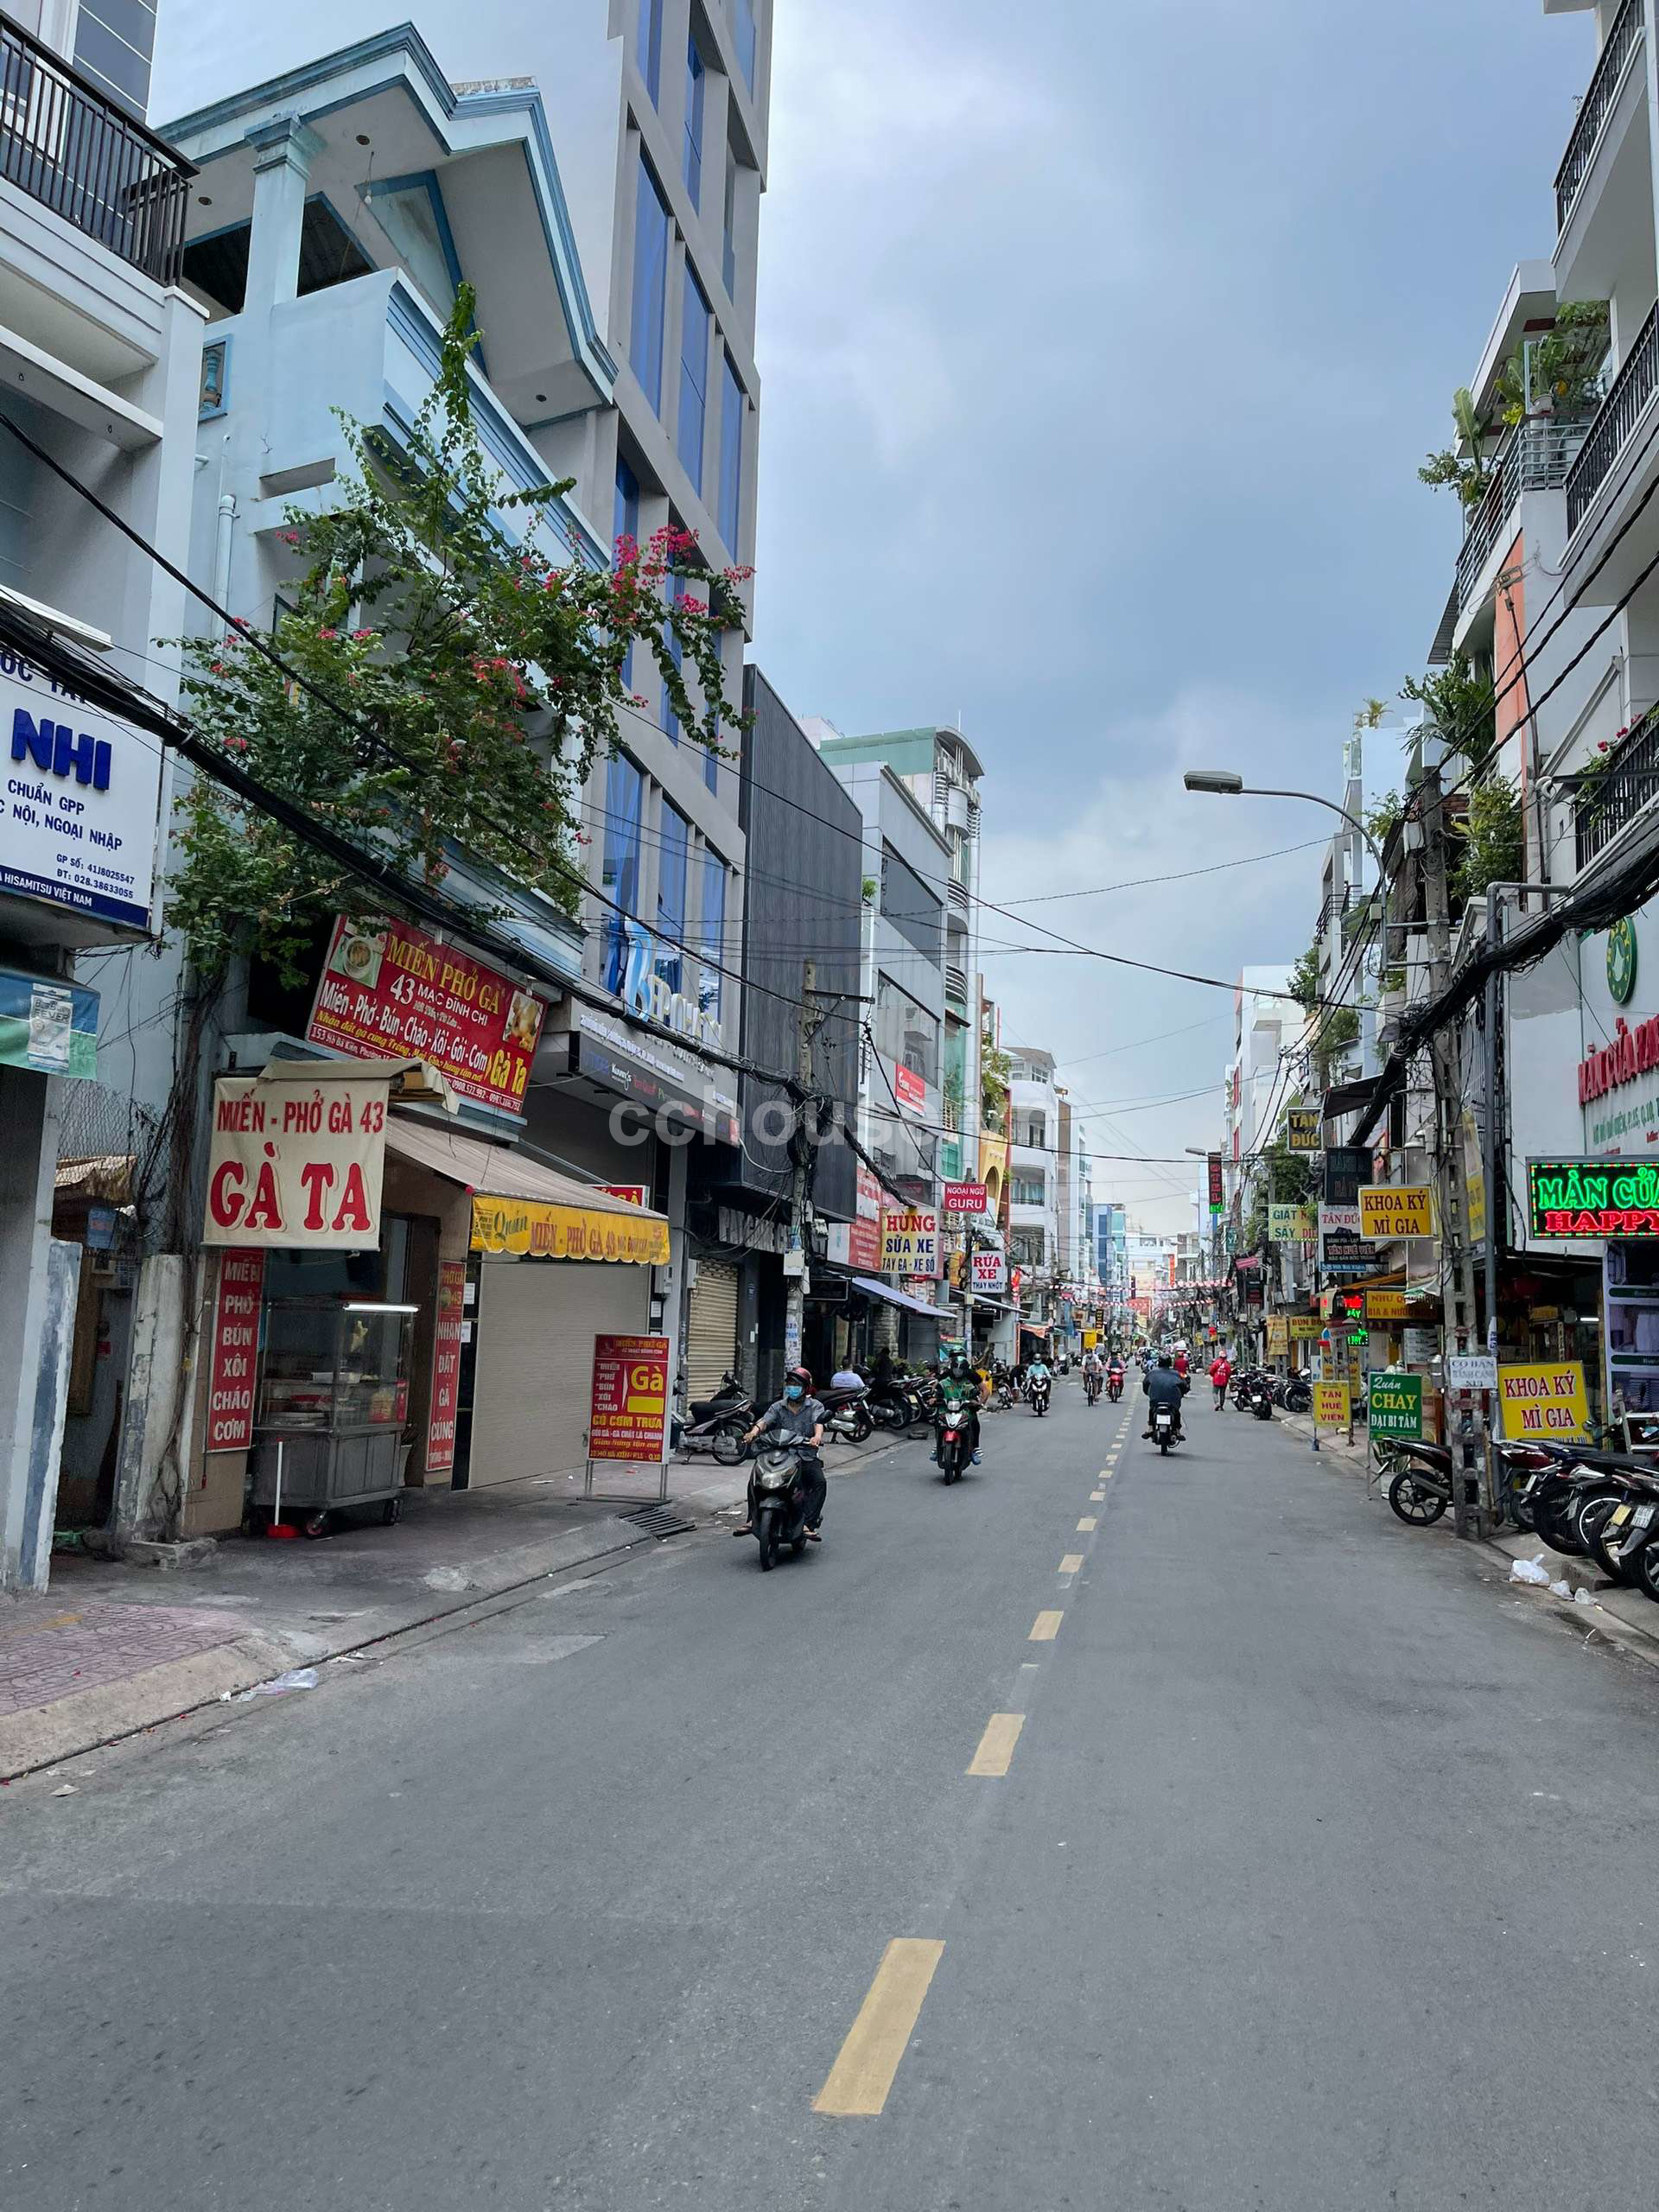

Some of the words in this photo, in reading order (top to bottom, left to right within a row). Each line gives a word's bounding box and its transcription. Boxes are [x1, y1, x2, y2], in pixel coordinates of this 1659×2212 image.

[11, 708, 112, 791] NHI
[8, 779, 53, 806] CHUẨN
[59, 796, 86, 815] GPP
[12, 804, 40, 828] NỘI,
[44, 814, 84, 841] NGOẠI
[89, 829, 123, 851] NHẬP
[56, 854, 68, 864] GP
[4, 873, 52, 895] HISAMITSU
[54, 886, 72, 902] VIỆT
[73, 893, 92, 906] NAM
[74, 874, 134, 899] 028.38633055
[386, 934, 441, 982] MIẾN
[439, 962, 479, 1001] PHỞ
[479, 982, 505, 1015] GÀ
[390, 974, 416, 1005] 43
[417, 983, 445, 1006] MẠC
[445, 996, 471, 1019] ĐĨNH
[471, 1009, 489, 1027] CHI
[319, 979, 351, 1016] Miến
[353, 994, 378, 1027] Phở
[379, 1005, 401, 1037] Bún
[404, 1016, 429, 1048] Cháo
[430, 1027, 450, 1056] Xôi
[468, 1044, 488, 1072] Cơm
[490, 1049, 512, 1090] Gà
[511, 1057, 528, 1096] Ta
[217, 1088, 266, 1134] MIẾN
[283, 1089, 325, 1134] PHỞ
[328, 1092, 353, 1134] GÀ
[359, 1102, 385, 1134] 43
[1291, 1112, 1319, 1128] TÂN
[1291, 1131, 1320, 1147] ĐỨC
[210, 1141, 283, 1230] GÀ
[301, 1162, 372, 1231] TA
[947, 1187, 969, 1198] NGOẠI
[1537, 1169, 1608, 1210] MÀN
[1612, 1166, 1659, 1210] CỬ
[948, 1198, 983, 1210] GURU
[1364, 1196, 1403, 1211] KHOA
[493, 1211, 529, 1242] Quán
[886, 1210, 937, 1232] HÙNG
[1321, 1211, 1342, 1224] TÂN
[1374, 1214, 1390, 1235] MÌ
[1395, 1219, 1421, 1235] GIA
[886, 1235, 912, 1253] SỬA
[917, 1238, 934, 1253] XE
[882, 1257, 896, 1271] TAY
[898, 1257, 907, 1271] GA
[914, 1258, 924, 1272] XE
[973, 1252, 1002, 1268] RỬA
[978, 1268, 996, 1280] XE
[225, 1289, 254, 1315] PHỞ
[222, 1321, 253, 1346] BÚN
[222, 1353, 247, 1376] XÔI
[631, 1365, 664, 1392] Gà
[1372, 1376, 1402, 1390] Quán
[1503, 1377, 1552, 1398] KHOA
[213, 1385, 250, 1410] CHÁO
[1371, 1393, 1418, 1410] CHAY
[636, 1416, 663, 1429] TRƯA
[1370, 1414, 1387, 1429] ĐẠI
[1388, 1414, 1396, 1427] BI
[1398, 1412, 1417, 1429] TÂM
[1521, 1403, 1542, 1430] MÌ
[1545, 1408, 1576, 1428] GIA
[213, 1420, 245, 1441] CƠM
